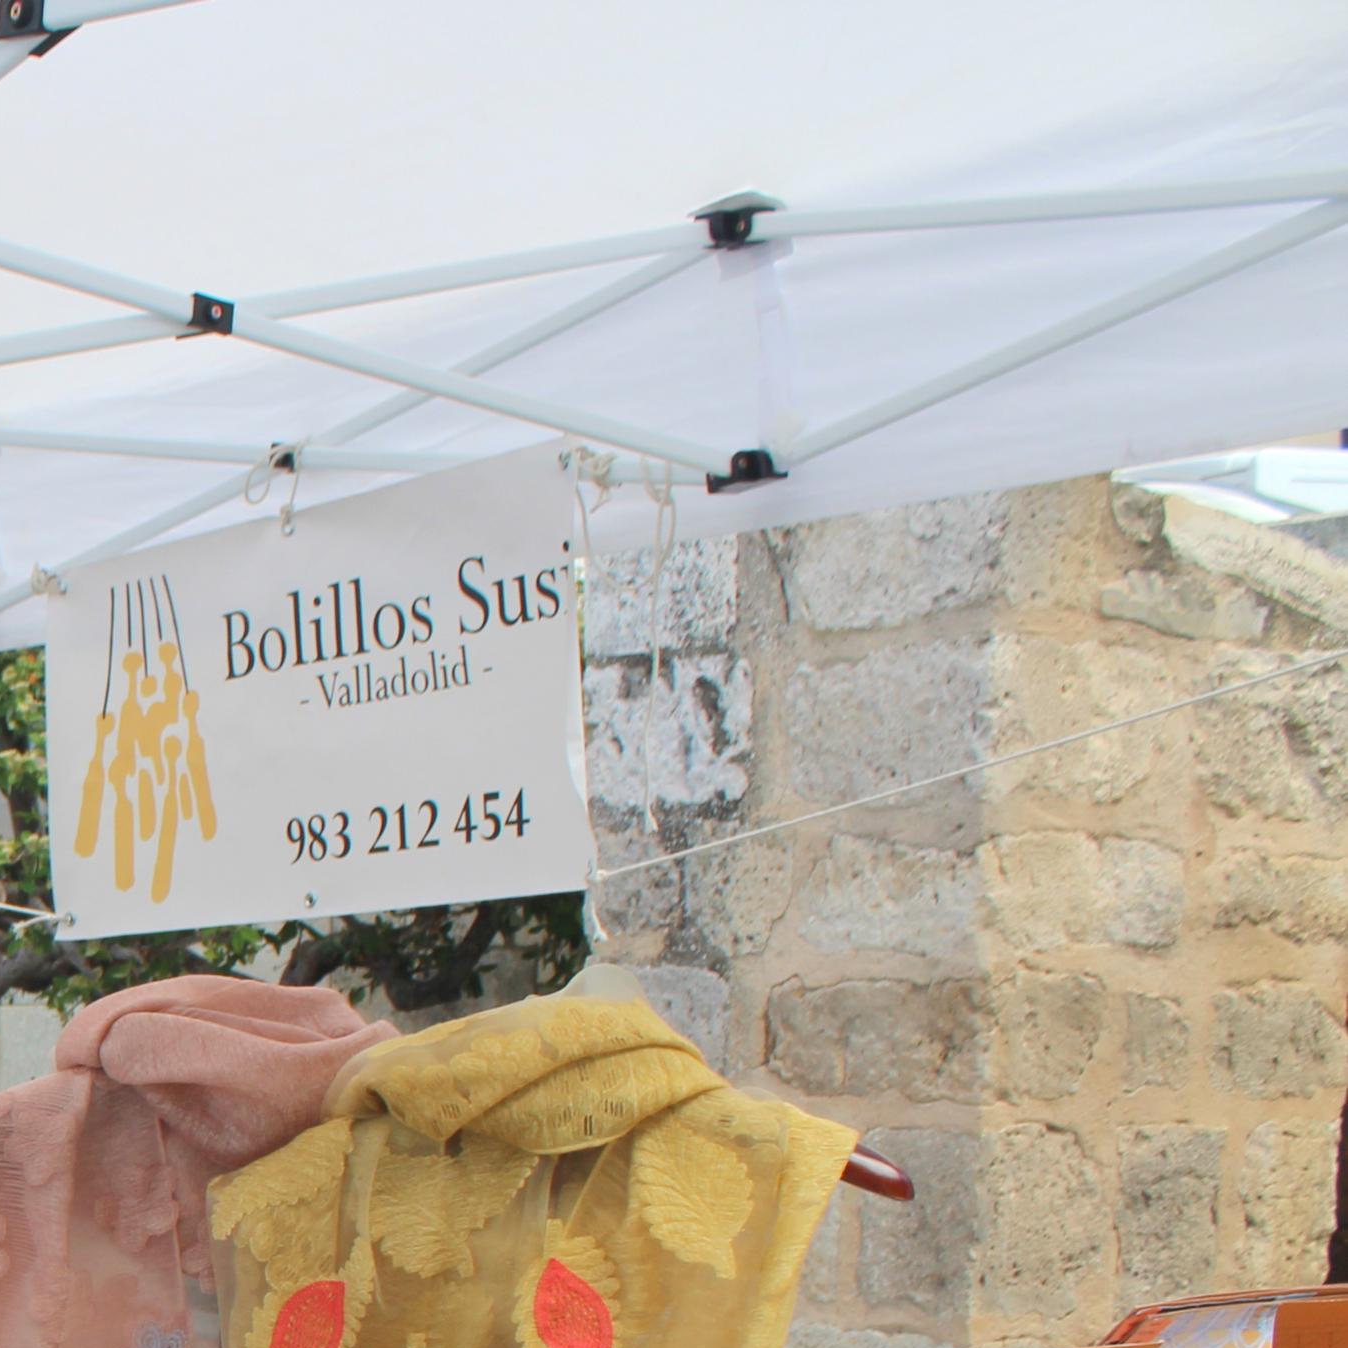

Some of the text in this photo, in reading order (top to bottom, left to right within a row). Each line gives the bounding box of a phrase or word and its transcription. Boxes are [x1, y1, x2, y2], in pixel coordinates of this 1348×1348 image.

[222, 577, 434, 681] Bolillos
[317, 645, 471, 709] Valladolid
[286, 787, 530, 865] 983 212 454
